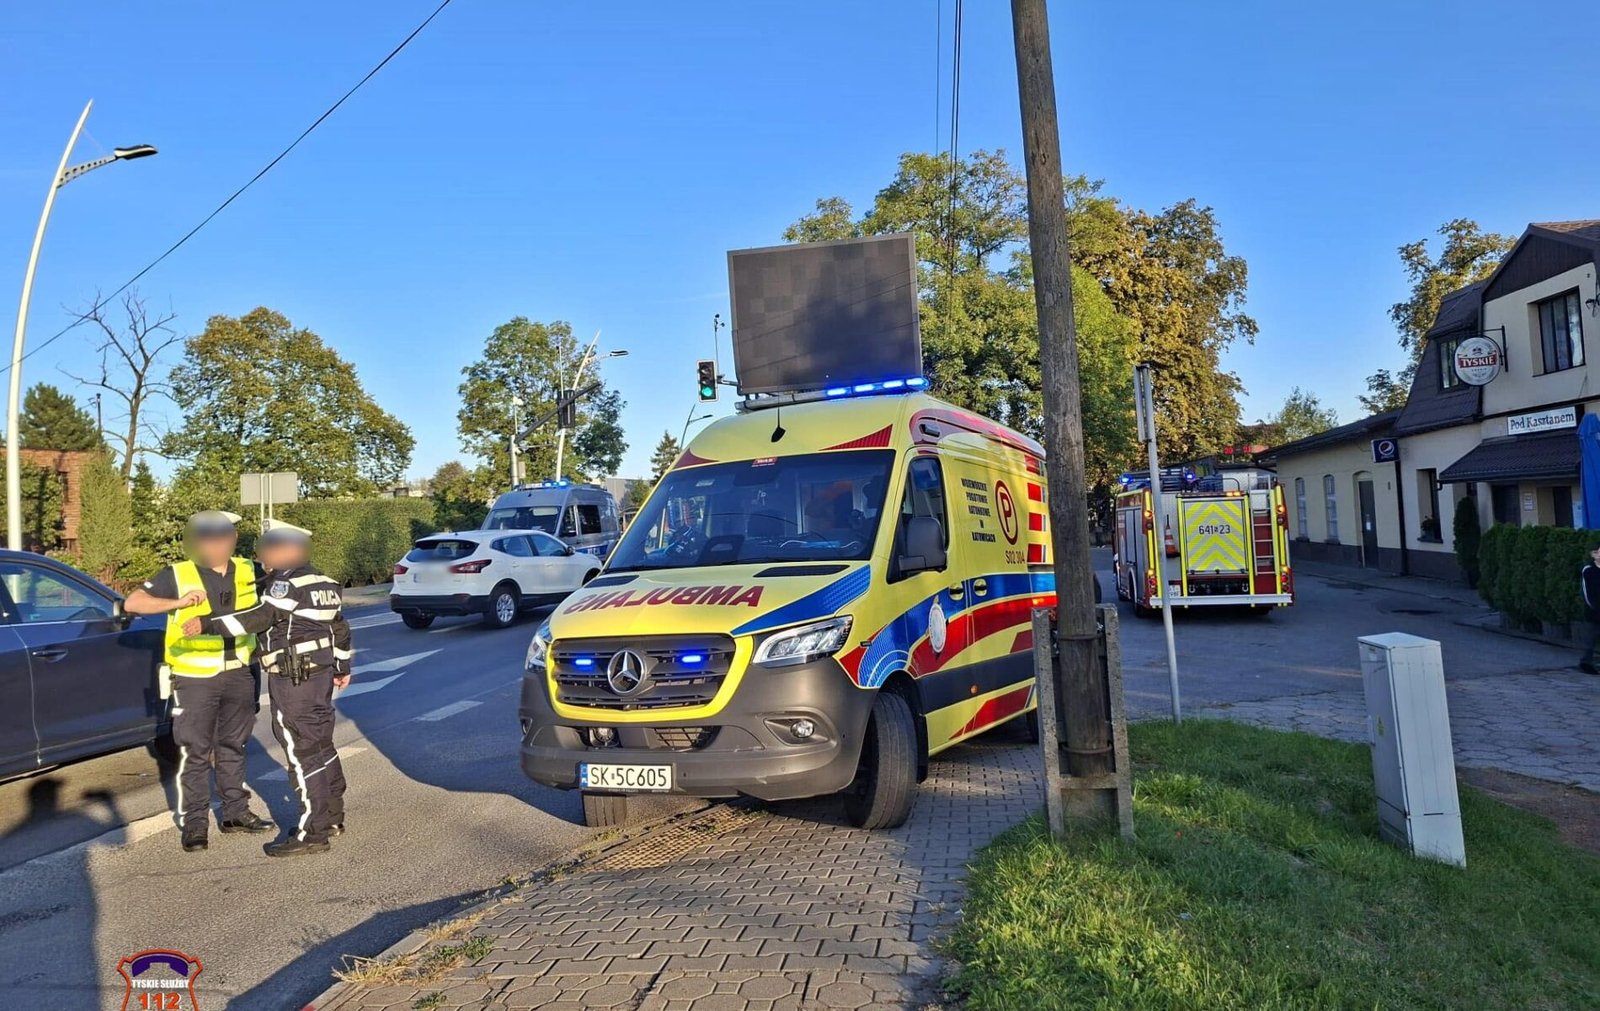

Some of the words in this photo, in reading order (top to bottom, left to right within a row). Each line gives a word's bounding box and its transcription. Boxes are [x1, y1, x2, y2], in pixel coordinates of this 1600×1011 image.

[1461, 356, 1495, 367] TYSKIE
[1510, 417, 1525, 430] Pod
[1527, 413, 1575, 427] Kasztanem
[591, 767, 609, 785] SK
[616, 768, 666, 787] 5C605
